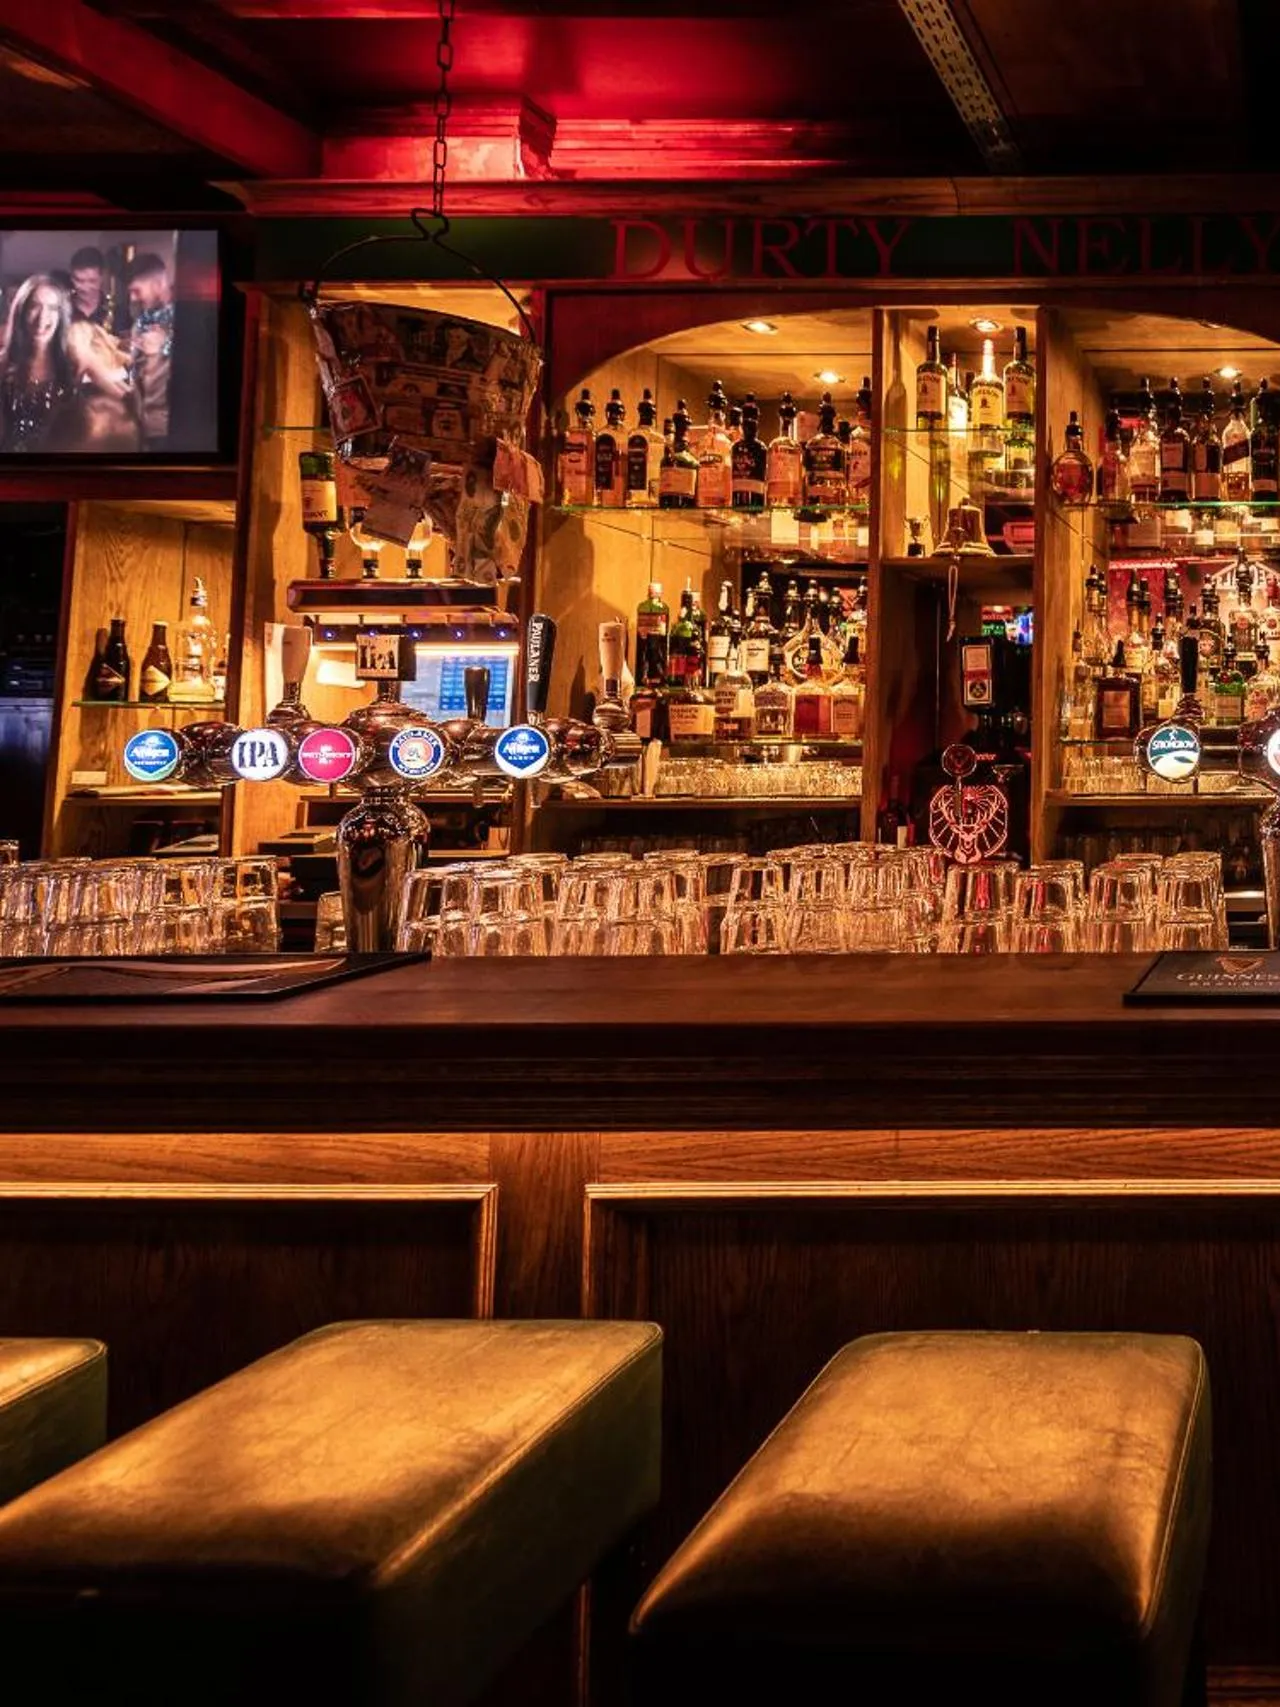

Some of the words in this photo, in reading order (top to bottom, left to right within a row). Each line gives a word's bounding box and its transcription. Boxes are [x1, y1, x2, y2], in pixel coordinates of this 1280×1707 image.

[609, 216, 914, 282] DURTY
[528, 621, 545, 683] PAULANER
[238, 741, 280, 768] IPA
